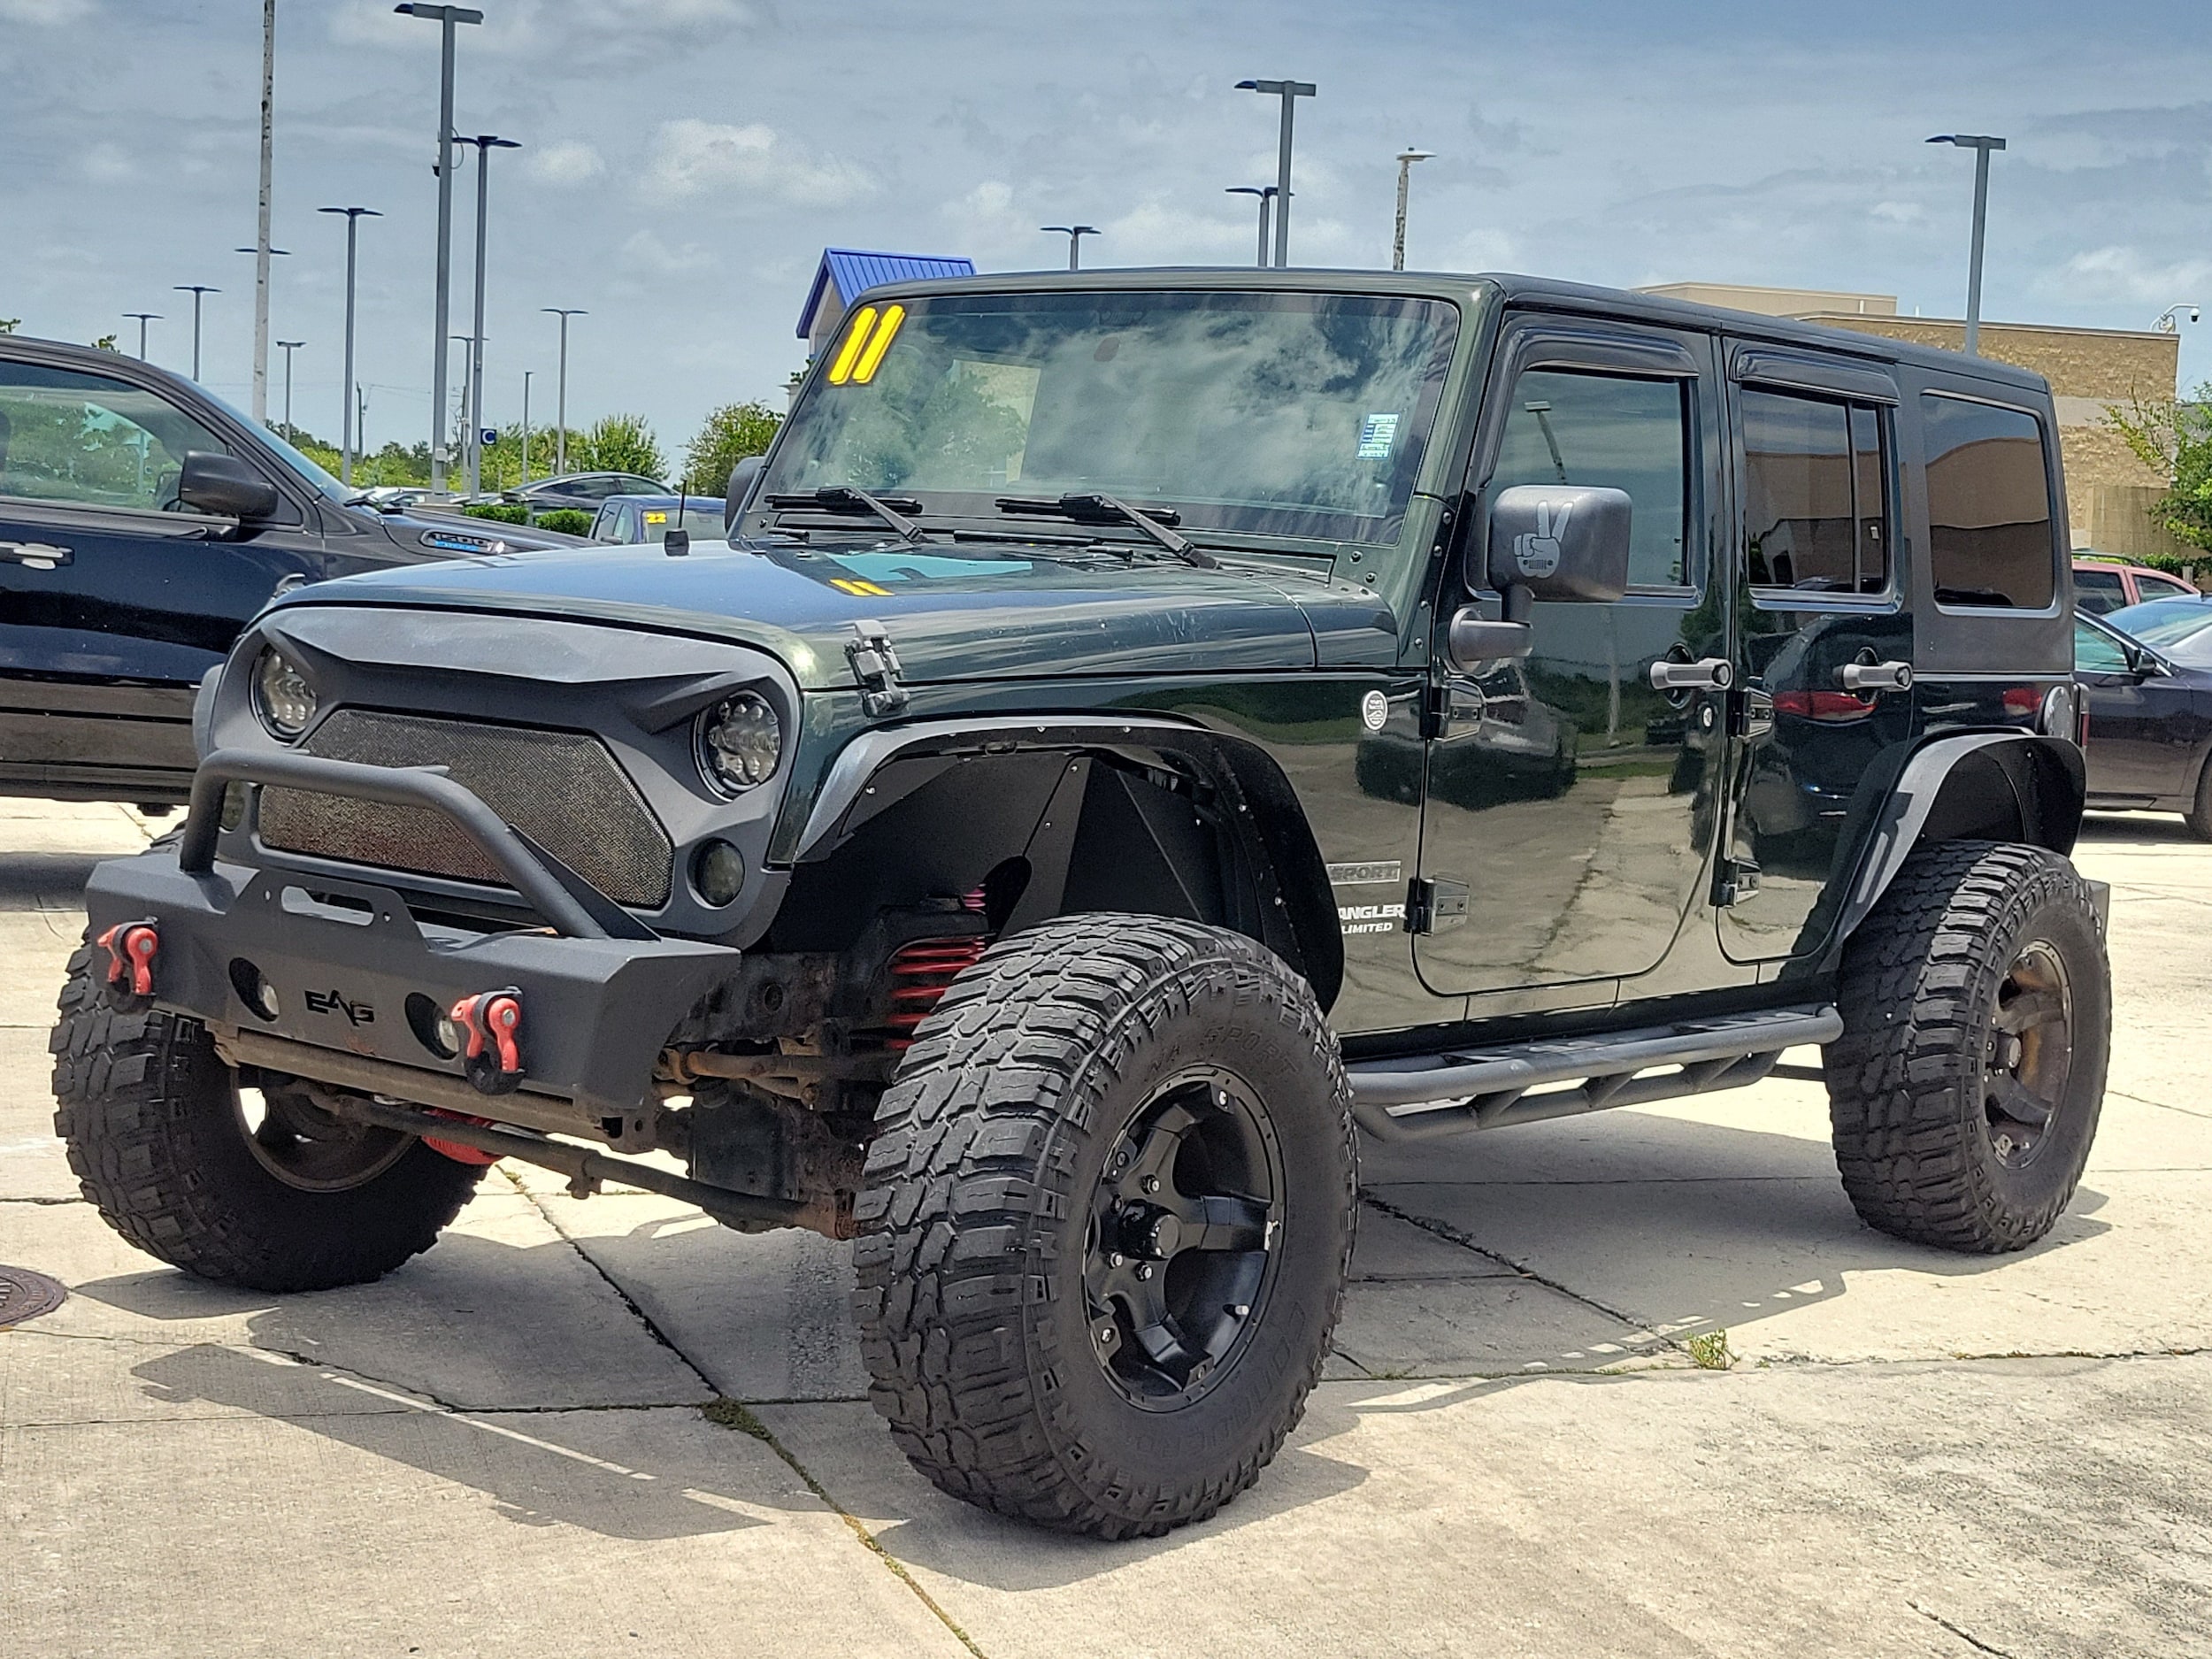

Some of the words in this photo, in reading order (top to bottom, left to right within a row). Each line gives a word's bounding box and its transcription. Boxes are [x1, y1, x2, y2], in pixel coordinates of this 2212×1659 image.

[482, 430, 495, 444] C
[646, 512, 666, 524] 22
[1341, 922, 1393, 934] LIMITED
